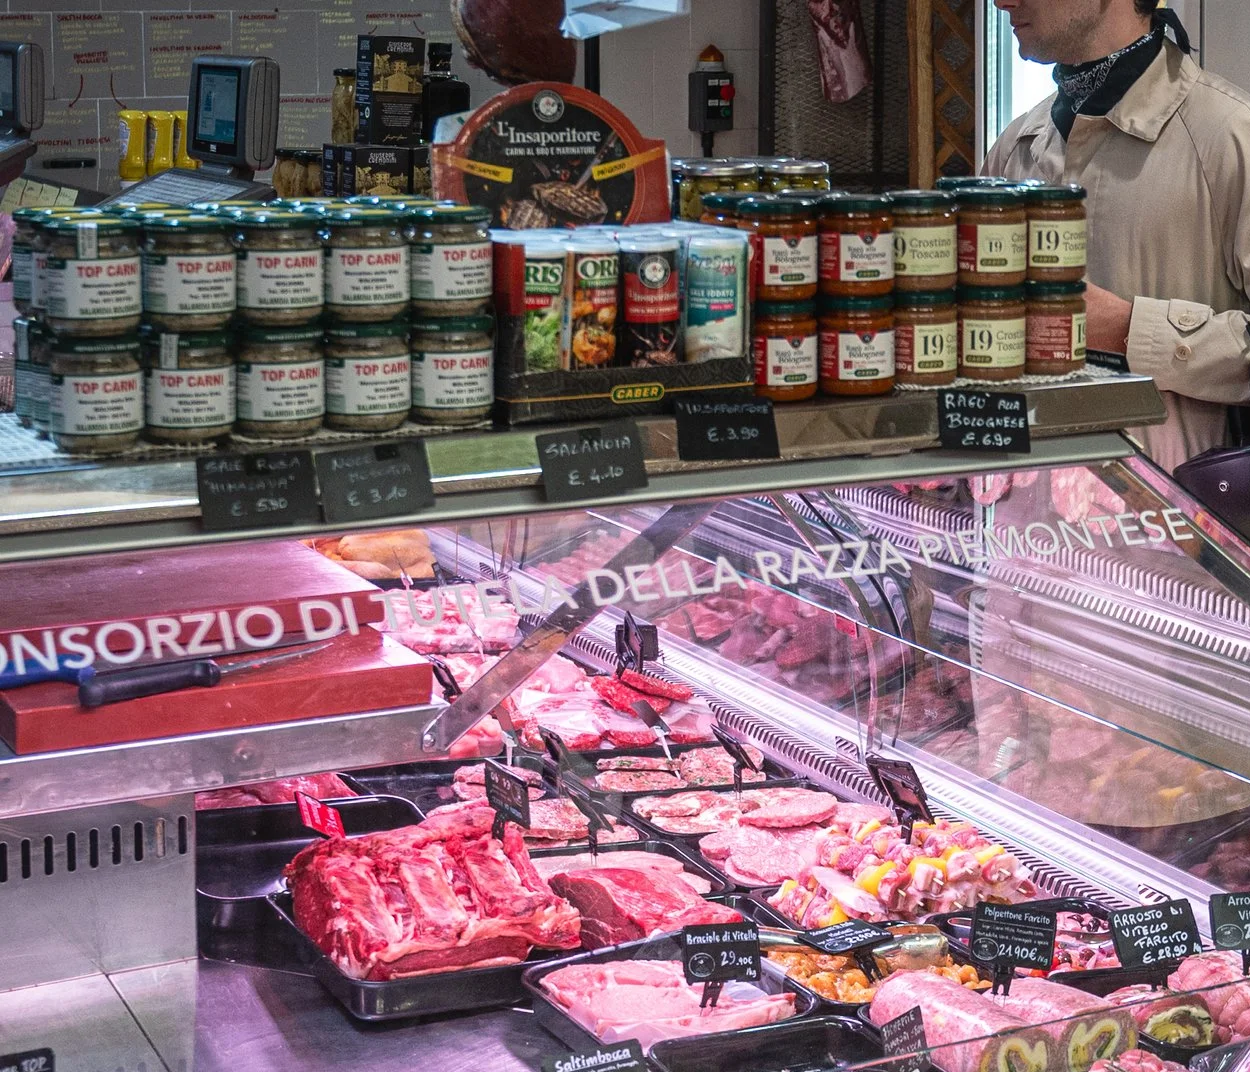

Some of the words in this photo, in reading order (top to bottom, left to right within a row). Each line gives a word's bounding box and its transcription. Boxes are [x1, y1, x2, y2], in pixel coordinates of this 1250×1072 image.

[505, 147, 526, 156] CARNI
[988, 240, 1002, 253] 19
[1035, 230, 1060, 252] 19
[1062, 231, 1087, 241] Crost
[1063, 242, 1087, 251] Tosca
[256, 256, 282, 269] TOP
[285, 255, 318, 269] CARNI
[341, 254, 365, 266] TOP
[367, 252, 401, 266] CARNI
[443, 250, 468, 262] TOP
[909, 250, 951, 260] Toscano
[77, 266, 101, 278] TOP
[177, 262, 203, 274] TOP
[525, 265, 561, 284] RIS
[580, 259, 618, 278] ORI
[922, 334, 944, 356] 19
[969, 329, 993, 351] 19
[996, 330, 1025, 340] Crosti
[996, 342, 1025, 352] Tosca
[355, 364, 379, 376] TOP
[433, 359, 457, 370] TOP
[461, 356, 490, 370] CARNI
[160, 375, 183, 388] TOP
[187, 374, 225, 387] CARNI
[260, 370, 285, 382] TOP
[290, 367, 321, 381] CARNI
[73, 382, 99, 395] TOP
[103, 379, 138, 393] CARNI
[617, 386, 659, 399] CABER
[997, 399, 1020, 411] ALLA
[945, 412, 1026, 429] BOLOGNESE
[982, 432, 1012, 447] 6.90
[0, 605, 284, 677] NSORZIO
[299, 597, 359, 642] DI
[369, 572, 580, 632] TUTELA
[587, 555, 748, 607] DELLA
[755, 538, 911, 587] RAZZA
[918, 507, 1195, 566] PIEMONTESE
[984, 906, 1023, 921] Polpettone
[1023, 912, 1051, 925] Farcito
[1113, 909, 1163, 929] ARROSTO
[686, 931, 721, 945] Braciole
[721, 930, 731, 942] di
[732, 928, 757, 942] Vitello
[1121, 922, 1168, 938] VITELLO
[1134, 932, 1188, 949] FARCITO
[21, 1056, 48, 1072] TOP
